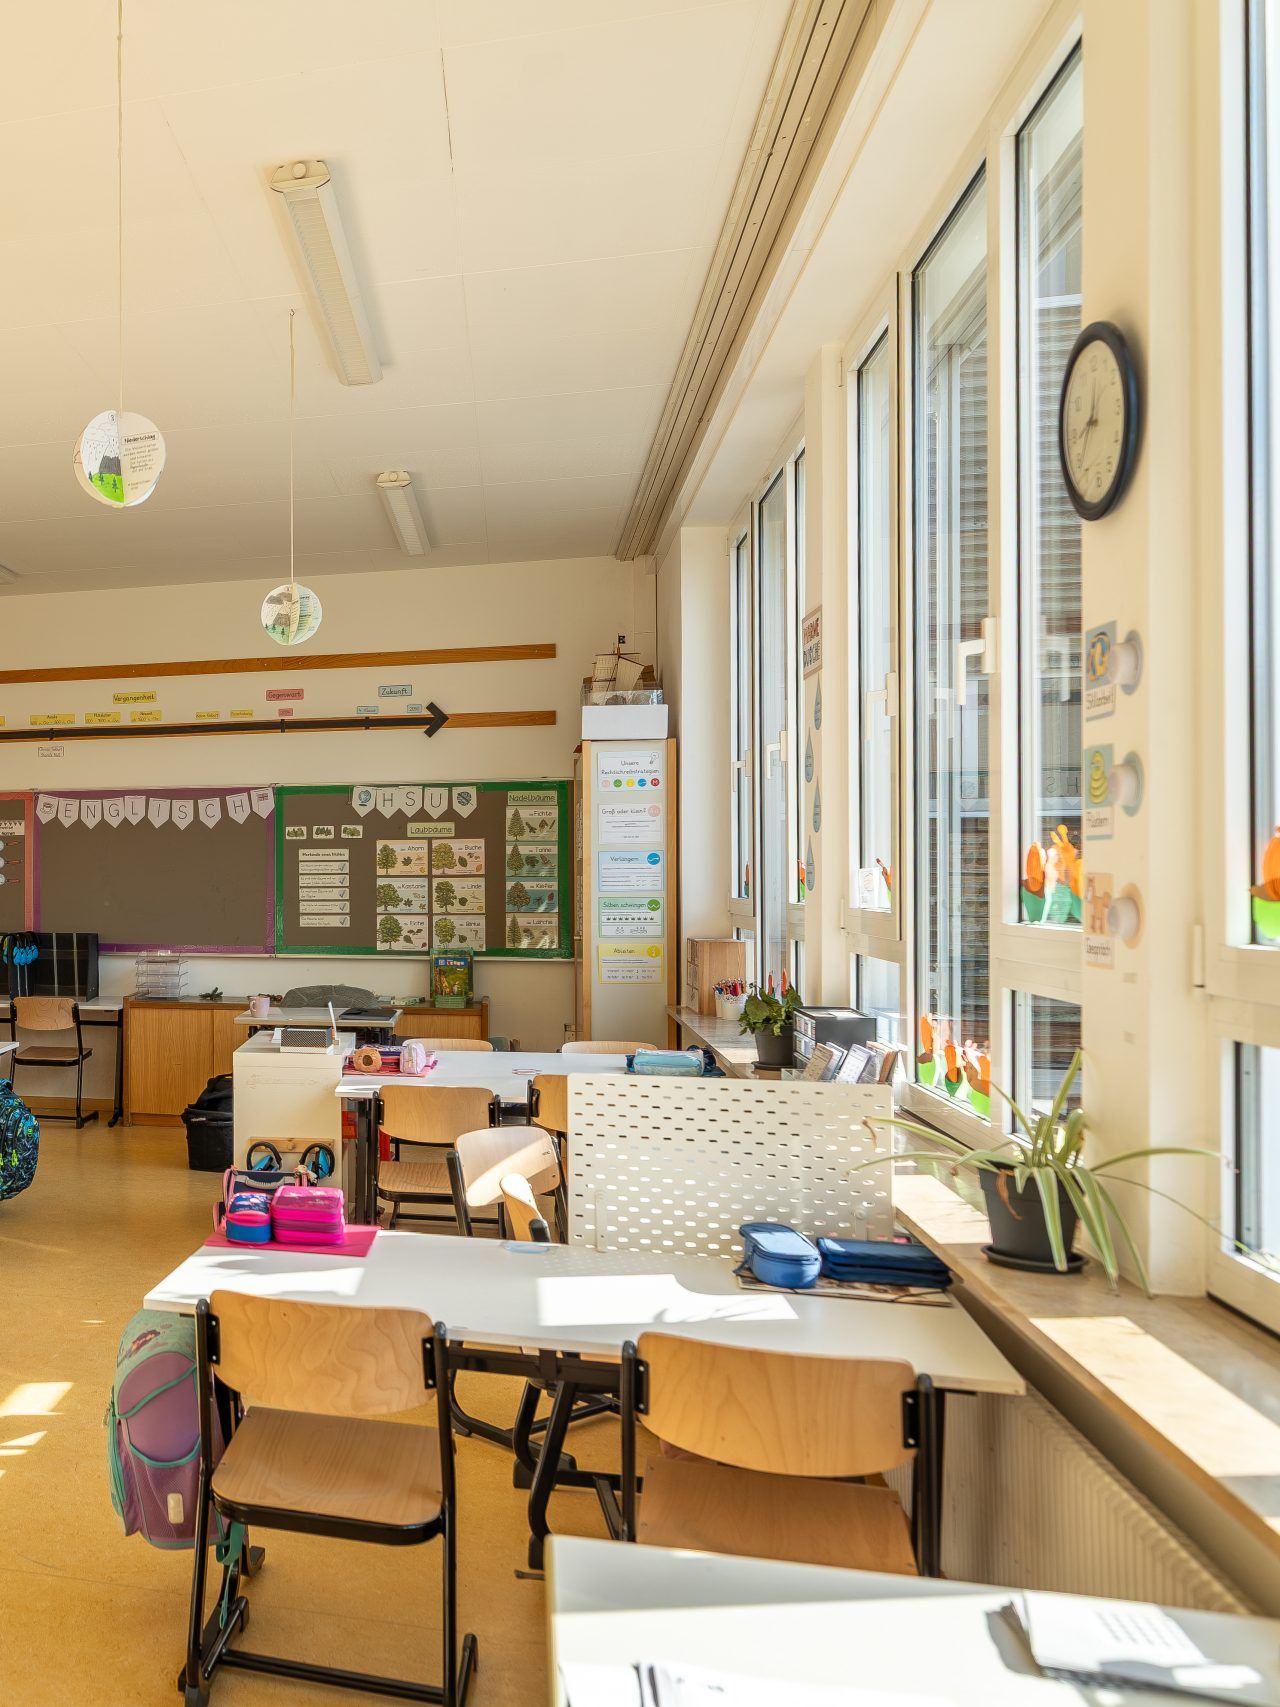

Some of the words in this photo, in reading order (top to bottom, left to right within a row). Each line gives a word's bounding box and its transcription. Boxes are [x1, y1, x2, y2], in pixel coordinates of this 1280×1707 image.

[267, 691, 302, 699] Gegenwart
[382, 687, 408, 695] Zukunft
[114, 692, 155, 703] Vergangenheit
[382, 791, 442, 808] HSU
[509, 794, 556, 802] Nadelbäume
[410, 826, 453, 834] Laubbäume
